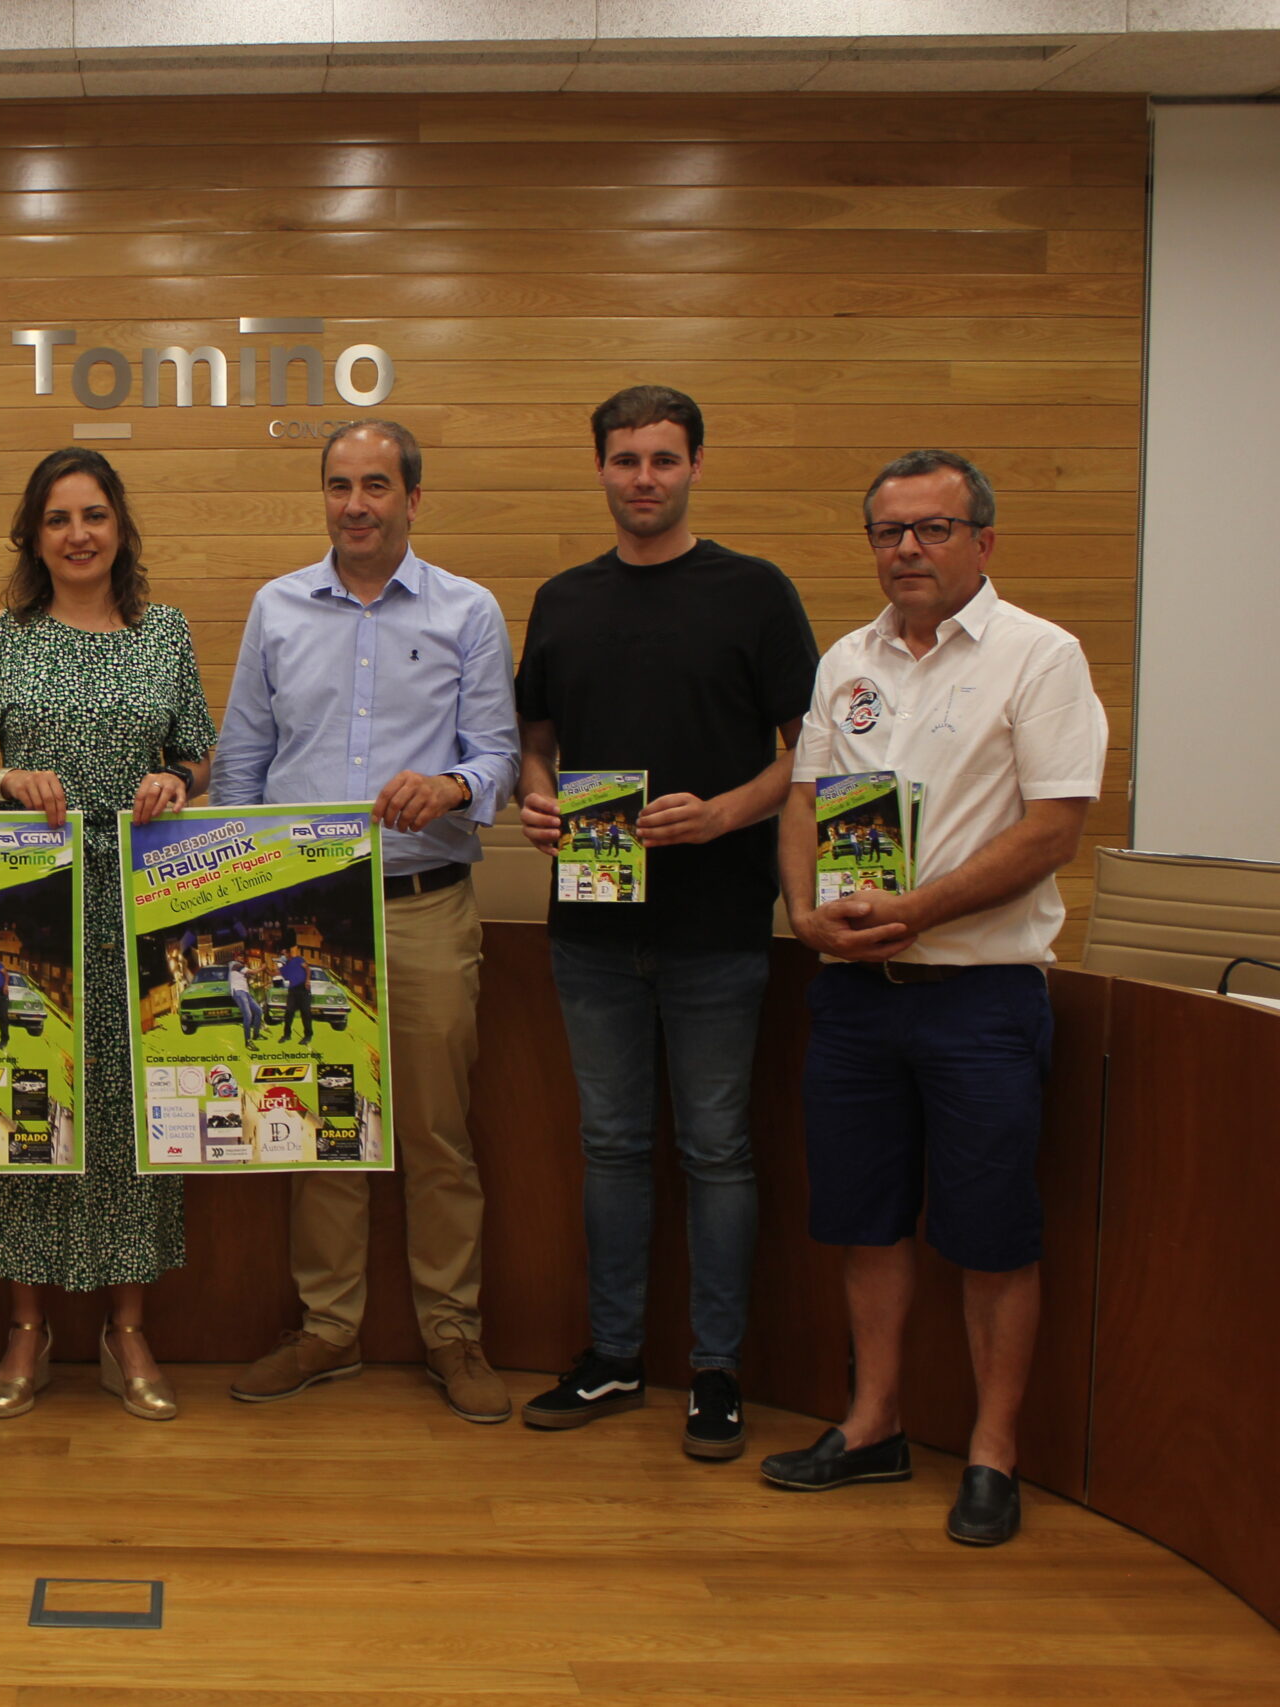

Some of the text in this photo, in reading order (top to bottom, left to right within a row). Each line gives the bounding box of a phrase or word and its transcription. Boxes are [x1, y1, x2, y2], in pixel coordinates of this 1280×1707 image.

[12, 317, 394, 410] Tomiño
[268, 419, 356, 438] CONC
[182, 842, 190, 852] E
[191, 835, 208, 849] 30
[297, 842, 355, 859] Tomiño
[0, 851, 56, 866] Tomiño
[147, 838, 256, 886] I Rallymix
[135, 888, 171, 906] Serra
[177, 871, 221, 892] Argallo
[233, 851, 282, 873] Figueiro
[217, 885, 229, 898] de
[166, 1054, 225, 1063] colaboración
[14, 1134, 48, 1142] DRADO
[322, 1130, 356, 1139] DRADO
